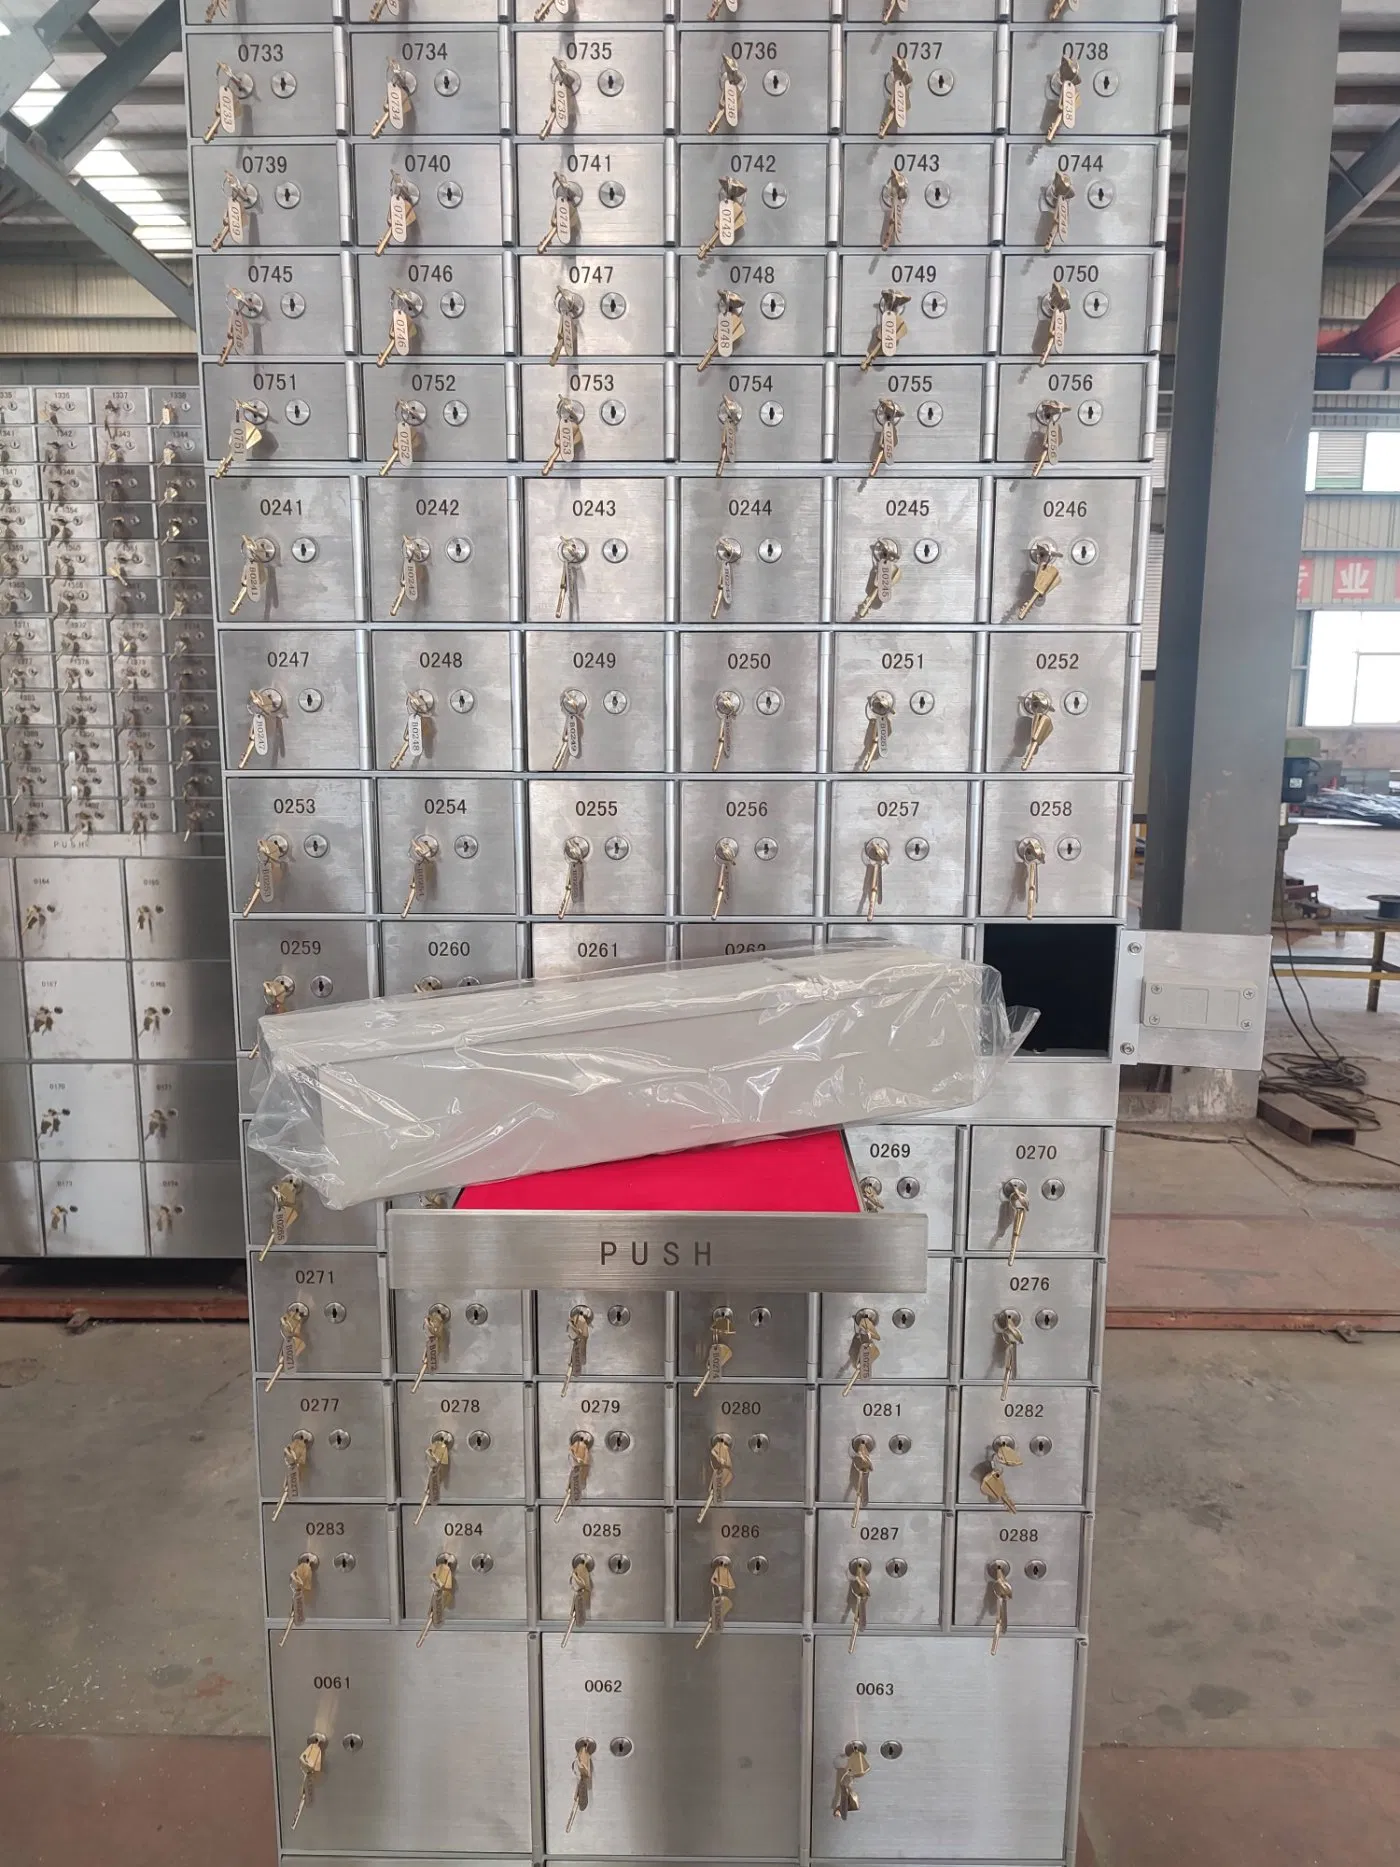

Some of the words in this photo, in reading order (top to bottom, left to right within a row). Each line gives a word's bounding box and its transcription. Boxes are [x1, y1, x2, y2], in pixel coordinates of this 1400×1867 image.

[237, 43, 284, 63] 0733
[401, 42, 448, 61] 0734
[564, 42, 612, 61] 0735
[731, 41, 777, 61] 0736
[896, 41, 943, 61] 0737
[1063, 41, 1109, 61] 0738
[222, 95, 232, 127] 0733
[391, 91, 401, 121] 0734
[557, 89, 566, 120] 0735
[727, 89, 736, 119] 0736
[897, 89, 906, 121] 0737
[1065, 90, 1074, 122] 0738
[242, 155, 288, 174] 0739
[404, 154, 451, 173] 0740
[566, 153, 611, 173] 0741
[730, 154, 776, 173] 0742
[893, 153, 940, 173] 0743
[1057, 154, 1104, 173] 0744
[231, 205, 239, 236] 0739
[394, 204, 403, 235] 0740
[560, 205, 568, 235] 0741
[723, 208, 731, 238] 0742
[247, 264, 293, 284] 0745
[408, 264, 453, 283] 0746
[568, 265, 614, 284] 0747
[729, 265, 775, 284] 0748
[891, 265, 937, 284] 0749
[1053, 264, 1099, 283] 0750
[397, 318, 406, 348] 0746
[720, 319, 729, 349] 0748
[885, 319, 893, 350] 0749
[253, 374, 297, 392] 0751
[411, 374, 456, 392] 0752
[568, 374, 615, 392] 0753
[728, 375, 774, 393] 0754
[887, 375, 933, 393] 0755
[1048, 373, 1093, 392] 0756
[235, 428, 243, 455] 0751
[400, 431, 409, 460] 0752
[562, 426, 571, 456] 0753
[885, 430, 894, 460] 0755
[1050, 429, 1058, 459] 0756
[260, 498, 302, 516] 0241
[415, 498, 460, 516] 0242
[572, 499, 617, 517] 0243
[728, 499, 773, 517] 0244
[885, 499, 930, 517] 0245
[1043, 500, 1088, 518] 0246
[881, 566, 890, 598] B0245
[267, 651, 310, 668] 0247
[419, 651, 463, 669] 0248
[572, 652, 616, 669] 0249
[727, 653, 771, 670] 0250
[881, 652, 923, 670] 0251
[1036, 652, 1079, 670] 0252
[411, 721, 420, 752] B0248
[273, 798, 316, 814] 0253
[424, 798, 468, 815] 0254
[575, 800, 618, 817] 0255
[726, 801, 768, 817] 0256
[876, 801, 920, 818] 0257
[1029, 800, 1073, 817] 0258
[280, 940, 321, 955] 0259
[428, 941, 471, 957] 0260
[577, 942, 617, 958] 0261
[869, 1143, 911, 1159] 0269
[1015, 1144, 1058, 1160] 0270
[600, 1241, 712, 1267] PUSH
[295, 1270, 334, 1284] 0271
[1009, 1276, 1050, 1292] 0276
[300, 1398, 339, 1412] 0277
[440, 1399, 480, 1413] 0278
[580, 1399, 621, 1414] 0279
[721, 1401, 761, 1415] 0280
[862, 1402, 901, 1417] 0281
[1004, 1403, 1044, 1418] 0282
[305, 1522, 346, 1537] 0283
[444, 1522, 483, 1537] 0284
[582, 1523, 622, 1538] 0285
[720, 1523, 761, 1539] 0286
[859, 1526, 899, 1541] 0287
[999, 1528, 1039, 1543] 0288
[313, 1675, 351, 1691] 0061
[583, 1678, 623, 1694] 0062
[856, 1682, 894, 1696] 0063
